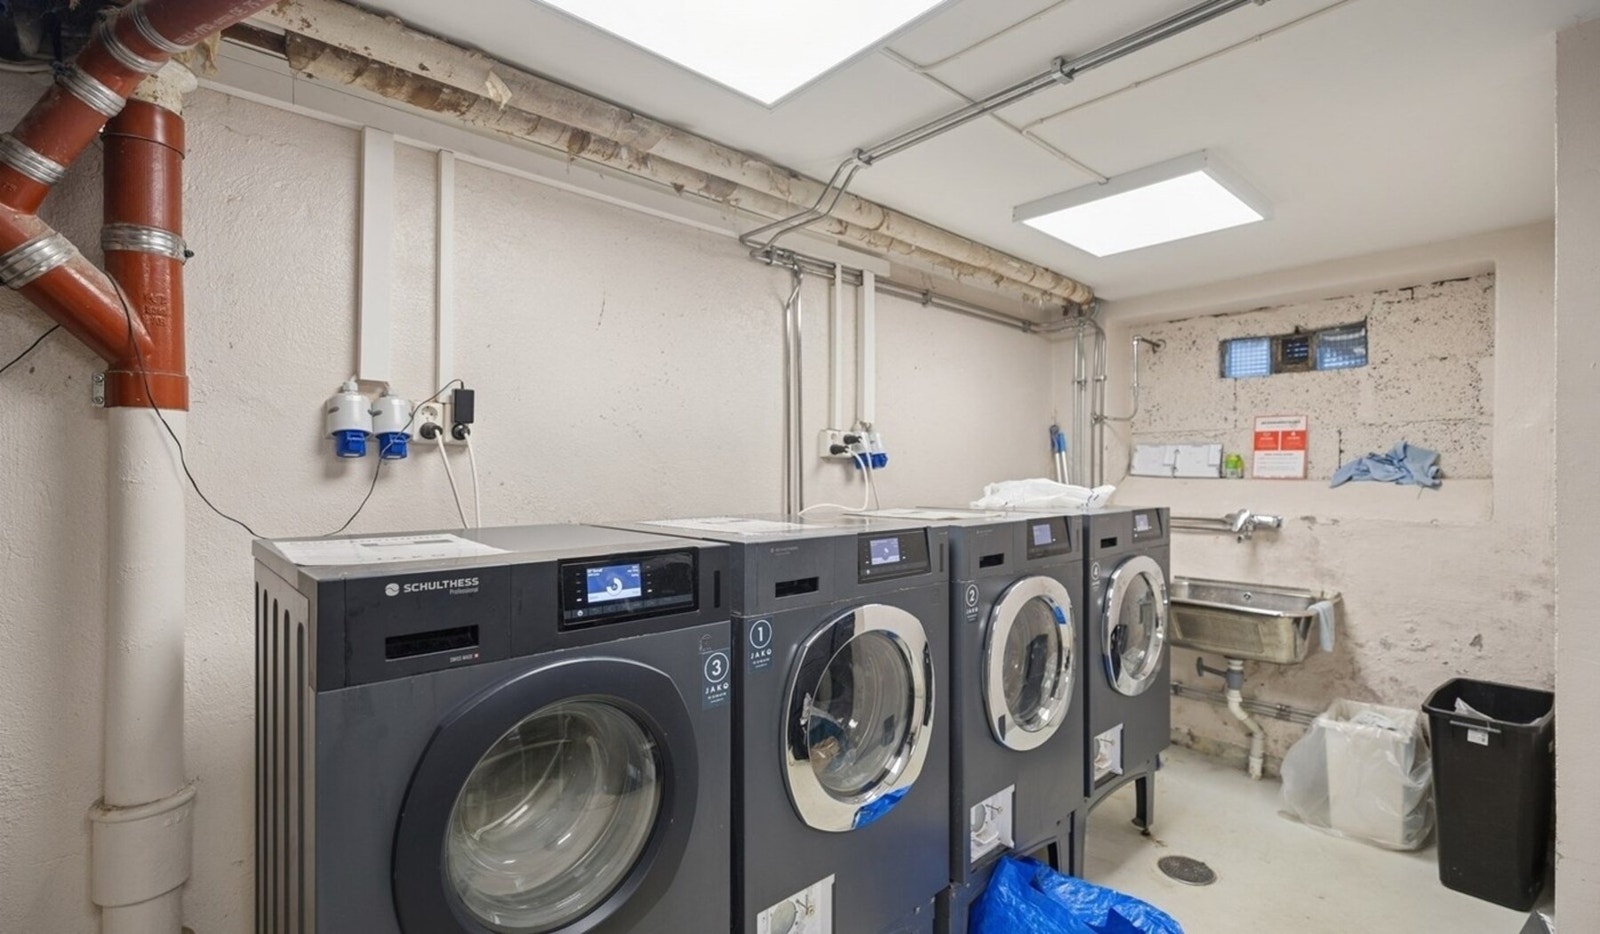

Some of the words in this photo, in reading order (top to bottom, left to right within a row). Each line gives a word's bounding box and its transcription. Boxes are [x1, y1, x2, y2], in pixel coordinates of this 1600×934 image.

[403, 577, 479, 593] SCHULTHESS
[969, 589, 975, 602] 2
[758, 627, 763, 641] 1
[750, 648, 772, 660] JAKO
[712, 659, 721, 676] 3
[705, 682, 729, 694] JAKO
